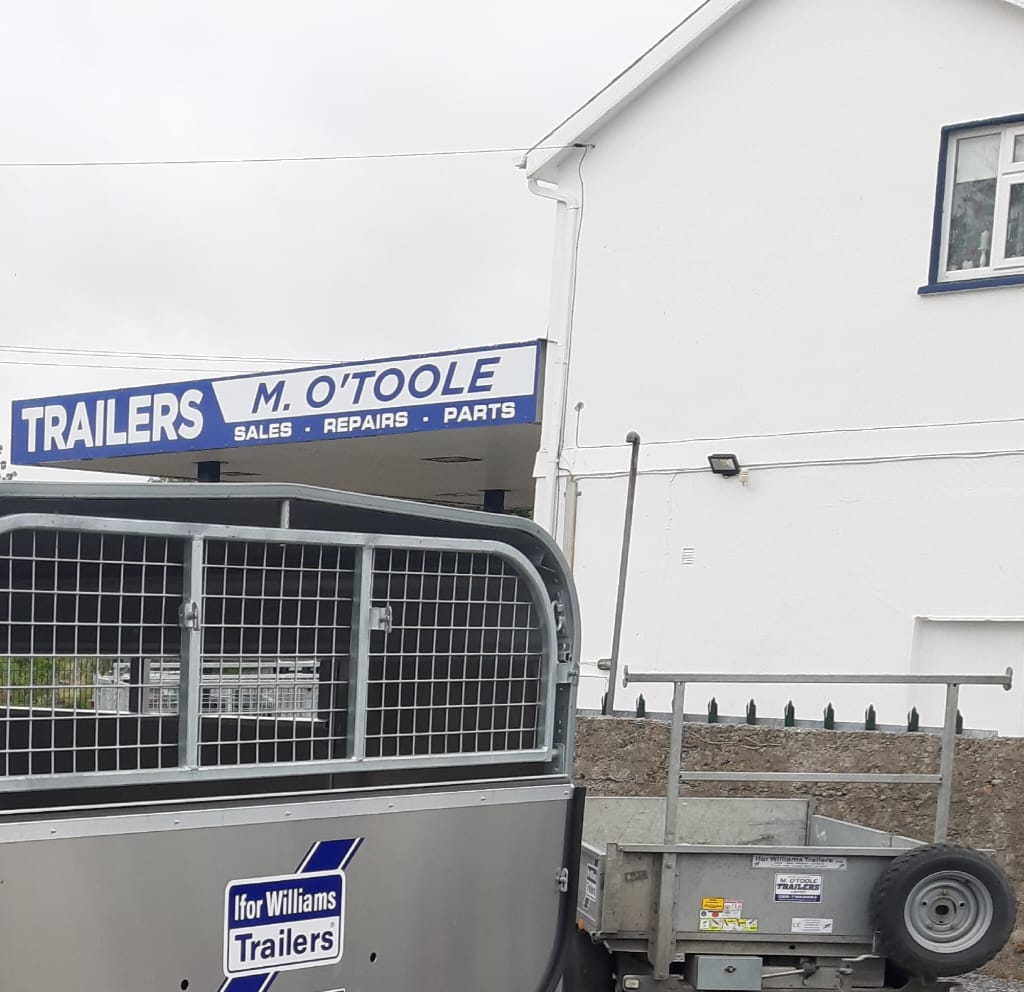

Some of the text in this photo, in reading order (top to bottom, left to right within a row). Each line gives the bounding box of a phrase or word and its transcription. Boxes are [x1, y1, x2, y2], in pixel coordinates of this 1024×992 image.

[251, 357, 501, 415] M. O'TOOLE
[21, 388, 205, 453] TRAILERS
[233, 401, 516, 442] SALES REPAIRS PARTS
[234, 887, 337, 921] Ifor Williams
[776, 883, 821, 891] TRAILERS
[234, 927, 335, 962] Trailers
